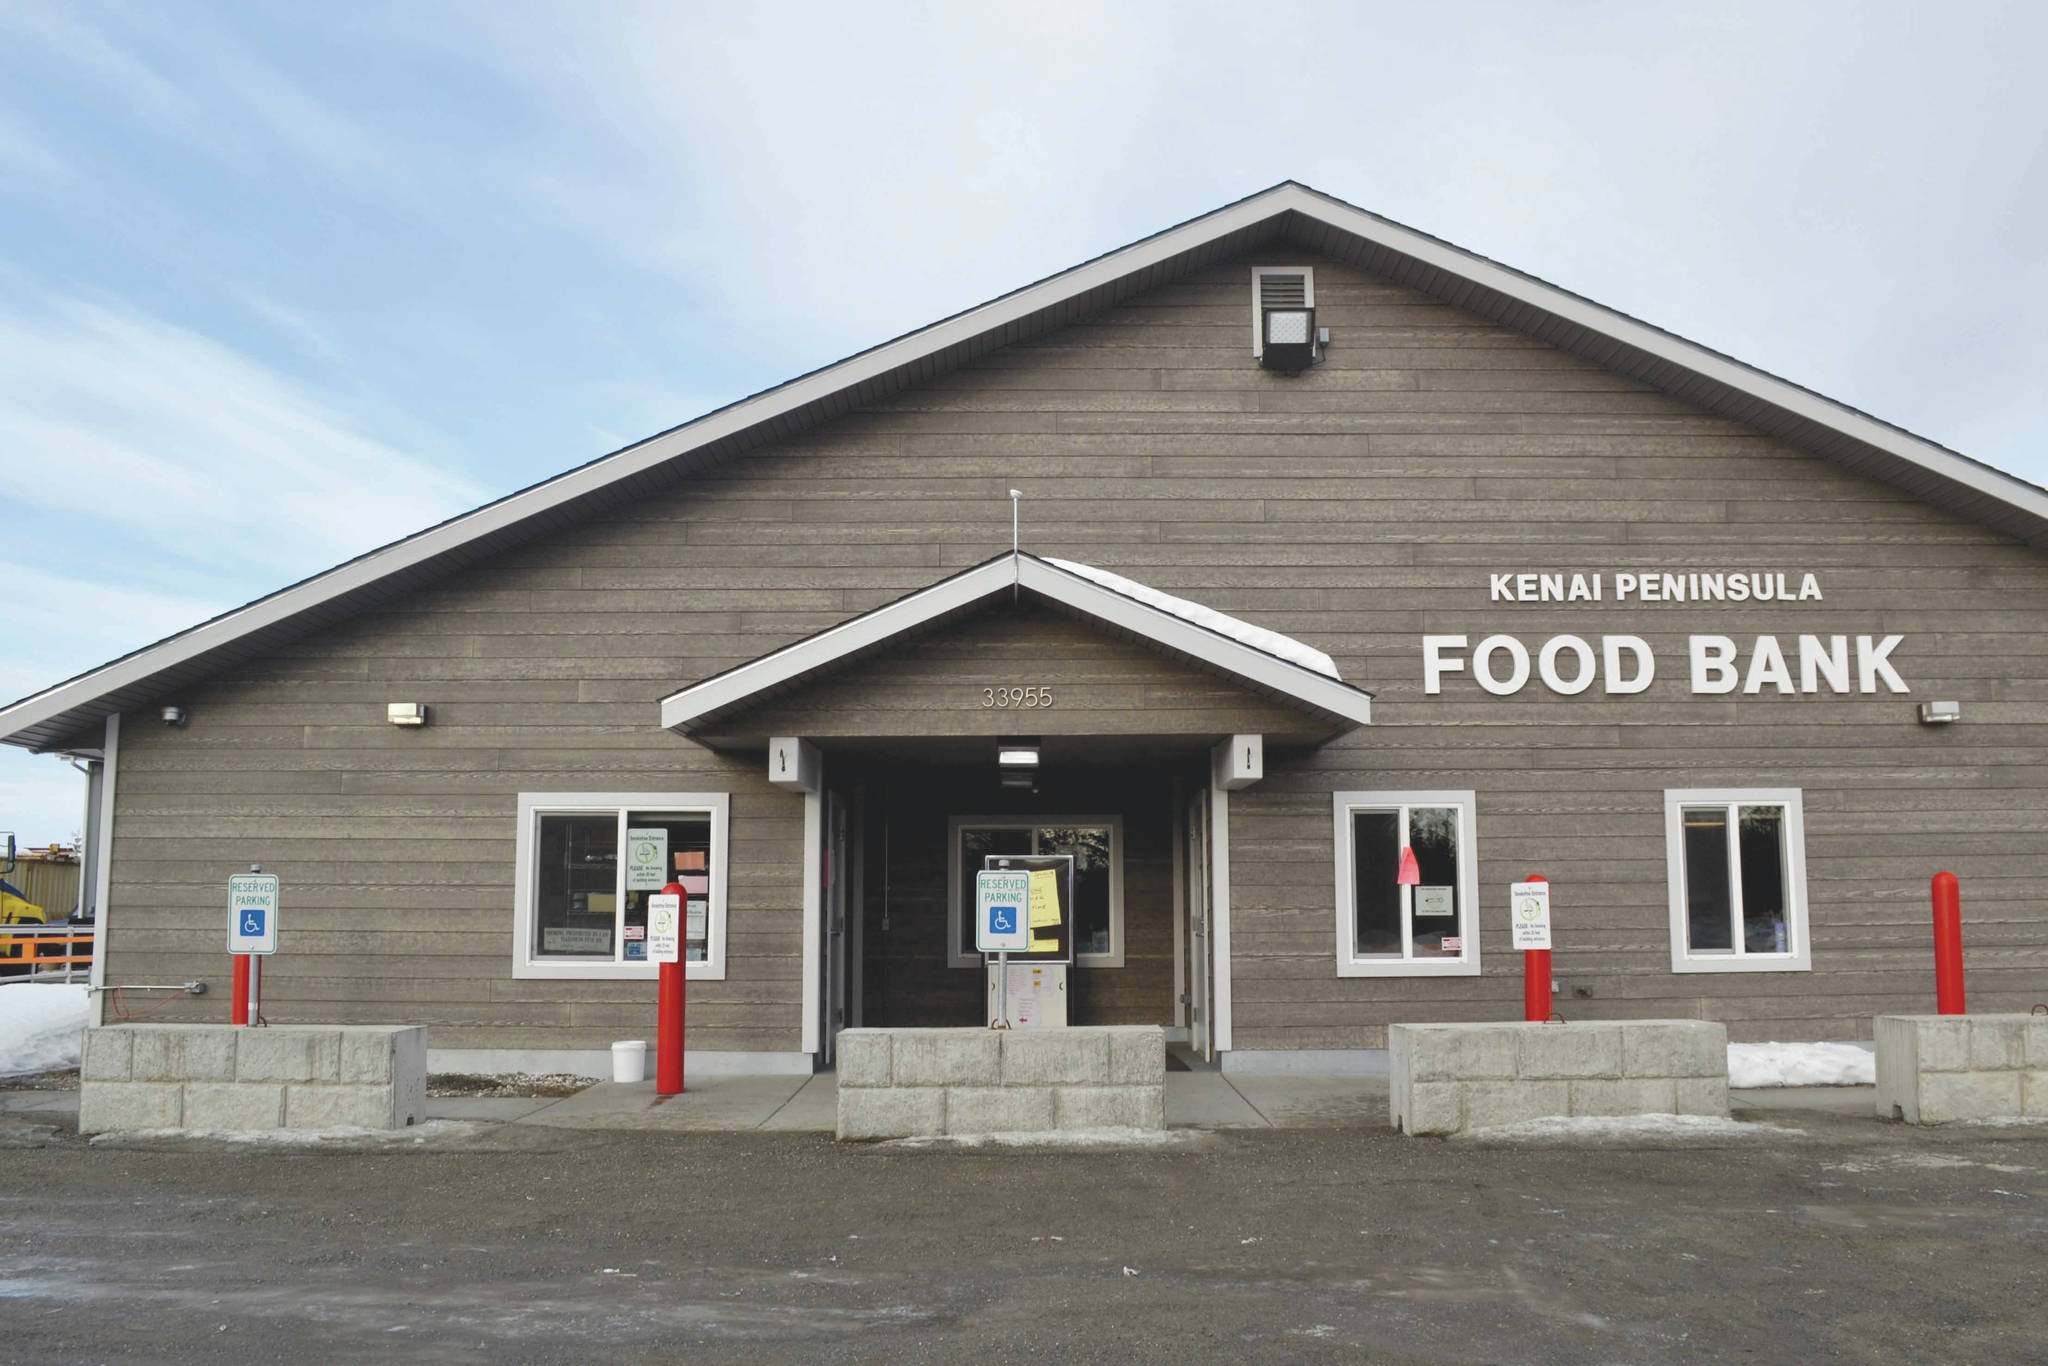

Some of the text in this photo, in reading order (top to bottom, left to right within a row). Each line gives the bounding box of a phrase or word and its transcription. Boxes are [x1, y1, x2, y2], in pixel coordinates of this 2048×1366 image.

[1490, 573, 1823, 601] KENAI PENINSULA
[1422, 634, 1911, 695] FOOD BANK
[982, 687, 1053, 707] 33955
[232, 882, 275, 893] RESERVED
[980, 880, 1026, 889] RESERVED
[236, 896, 270, 906] PARKING
[984, 893, 1022, 903] PARKING
